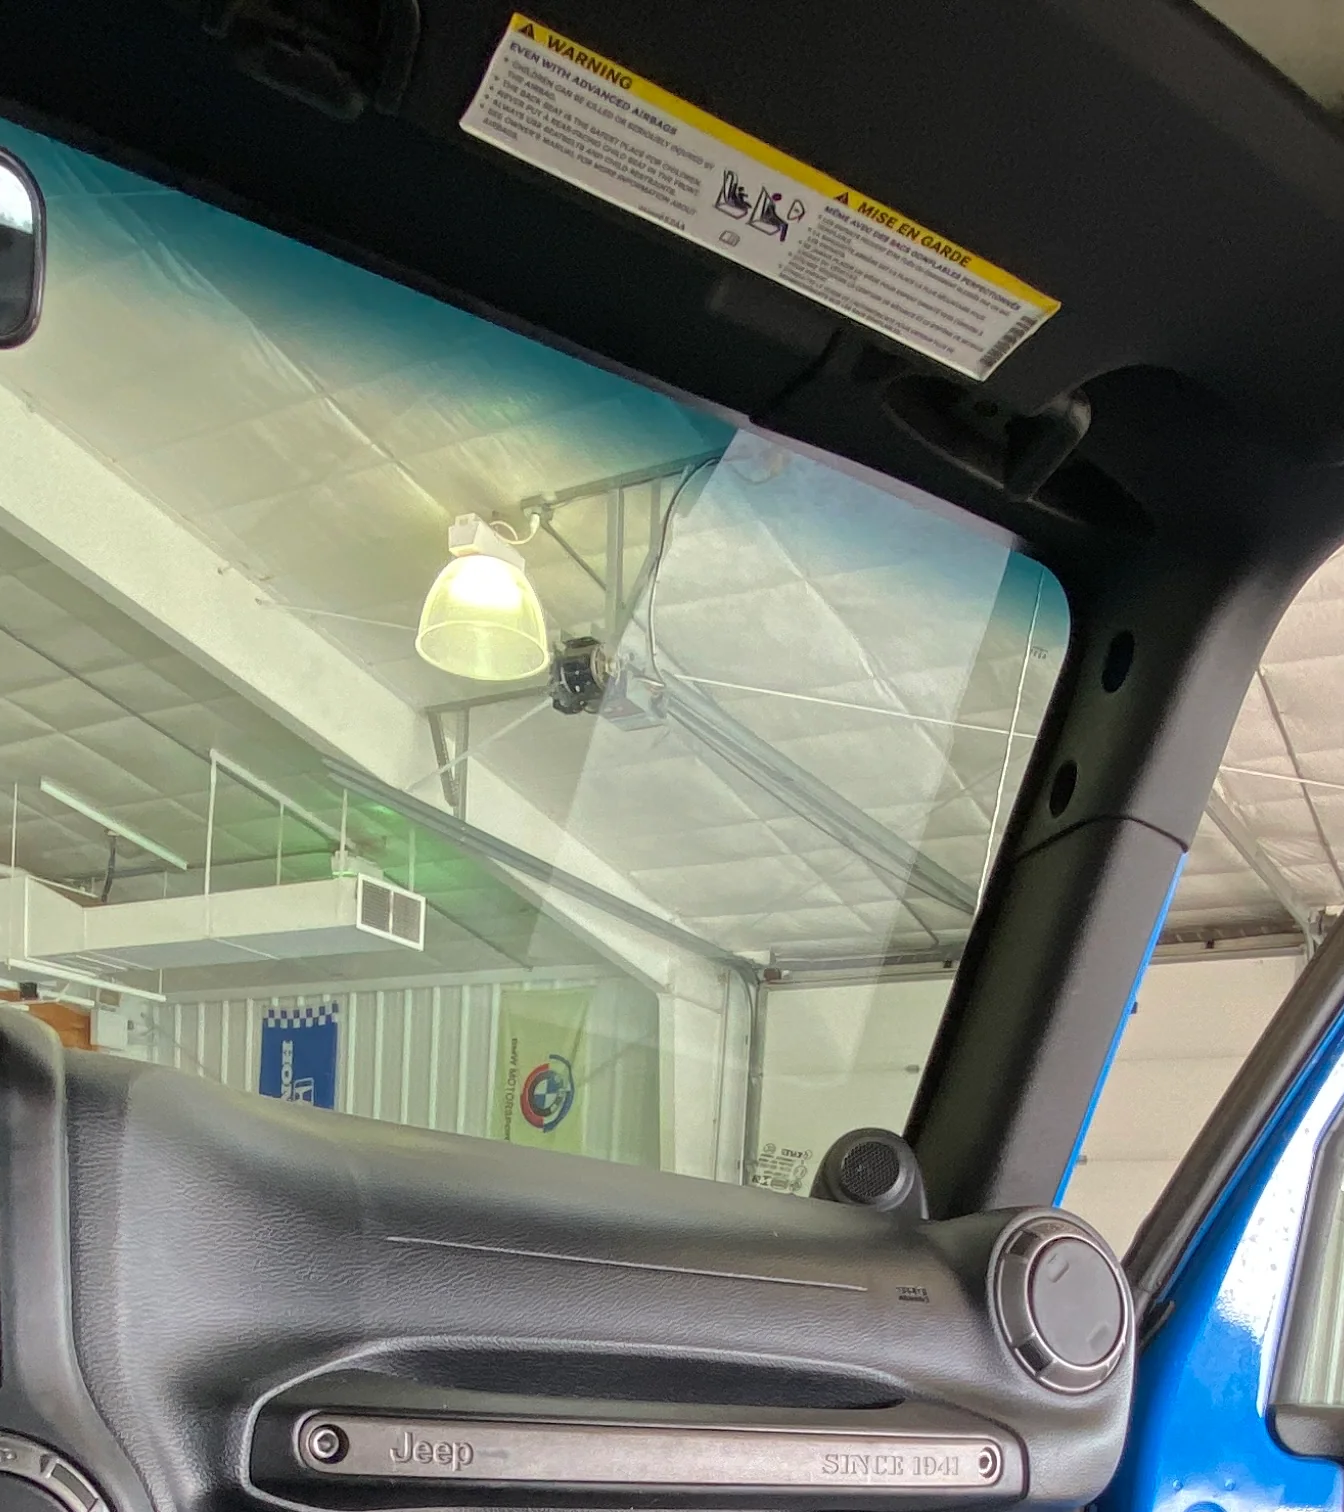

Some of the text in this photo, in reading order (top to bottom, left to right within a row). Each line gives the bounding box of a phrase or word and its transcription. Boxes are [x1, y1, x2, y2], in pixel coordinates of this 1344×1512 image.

[543, 33, 635, 91] WARNING
[508, 40, 679, 136] EVEN WITH ADVANCED AIRBAGS
[855, 200, 973, 268] MISE EN GARDE
[510, 1038, 518, 1066] BMW
[389, 1431, 474, 1472] Jeep
[821, 1453, 960, 1476] SINCE 1941
